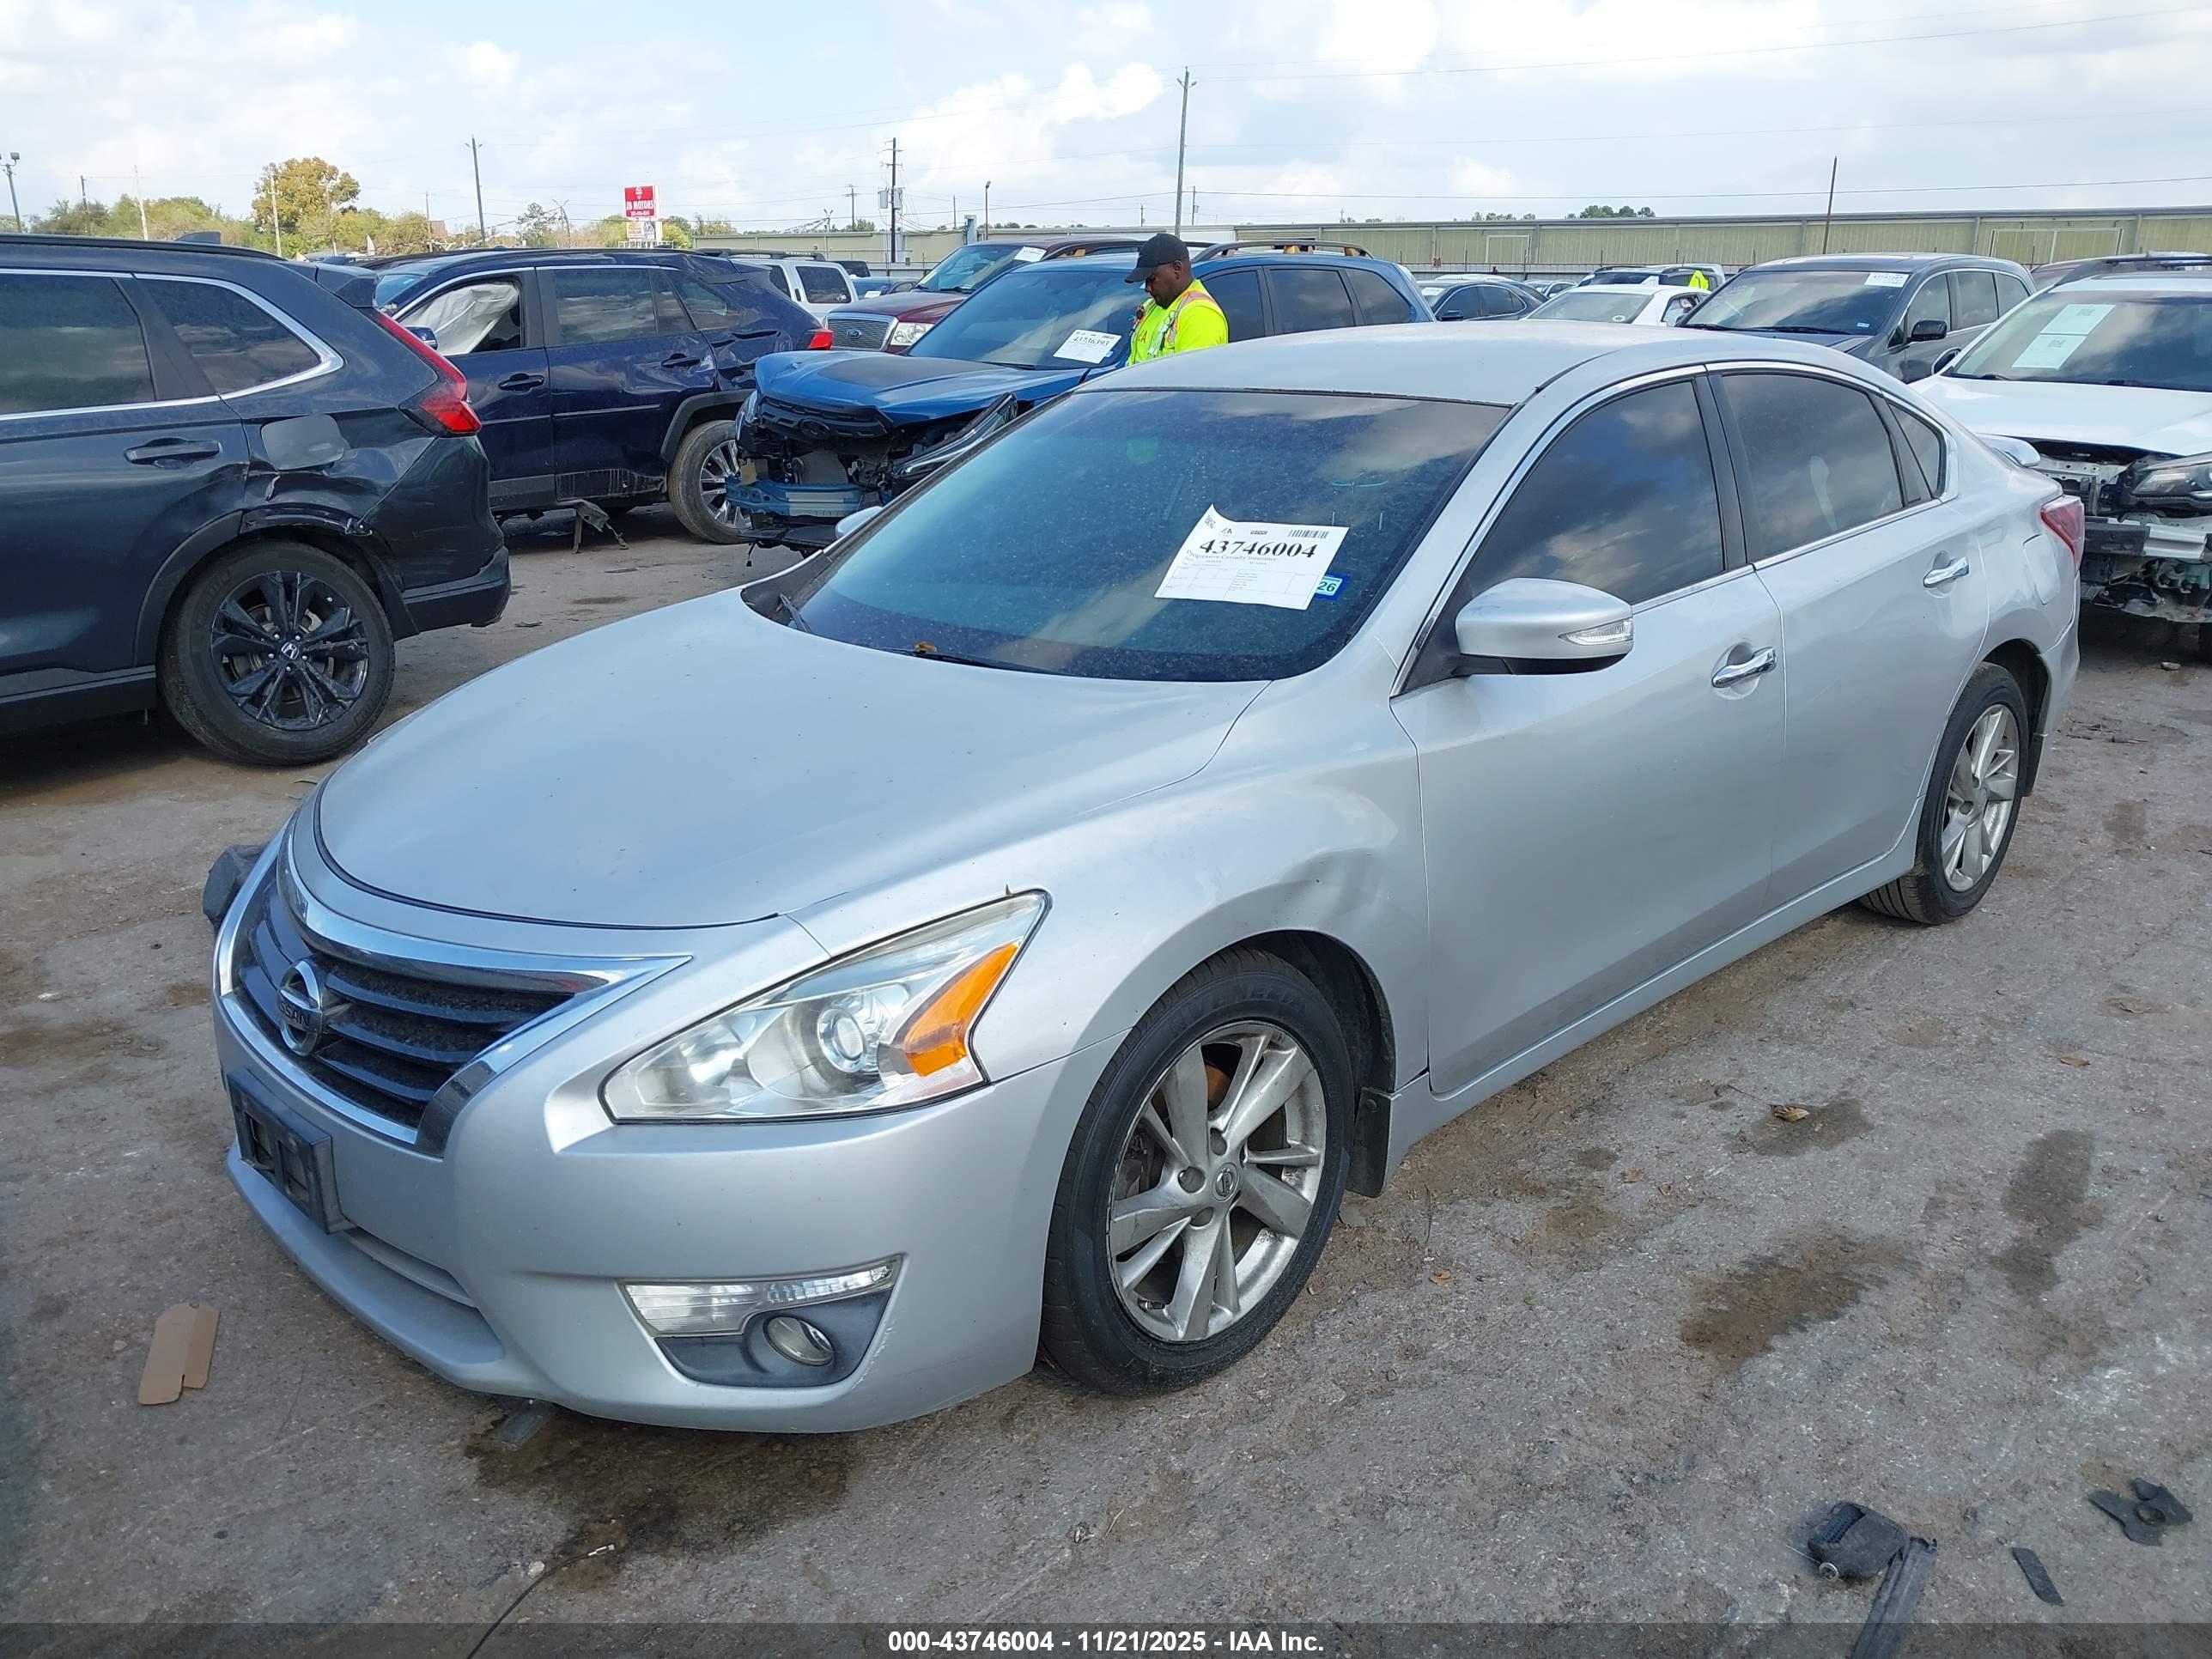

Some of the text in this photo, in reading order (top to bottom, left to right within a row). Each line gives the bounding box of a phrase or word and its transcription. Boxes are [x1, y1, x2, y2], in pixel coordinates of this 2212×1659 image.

[634, 200, 653, 210] MOTORS
[1200, 538, 1318, 558] 43746004
[1316, 580, 1336, 592] 26
